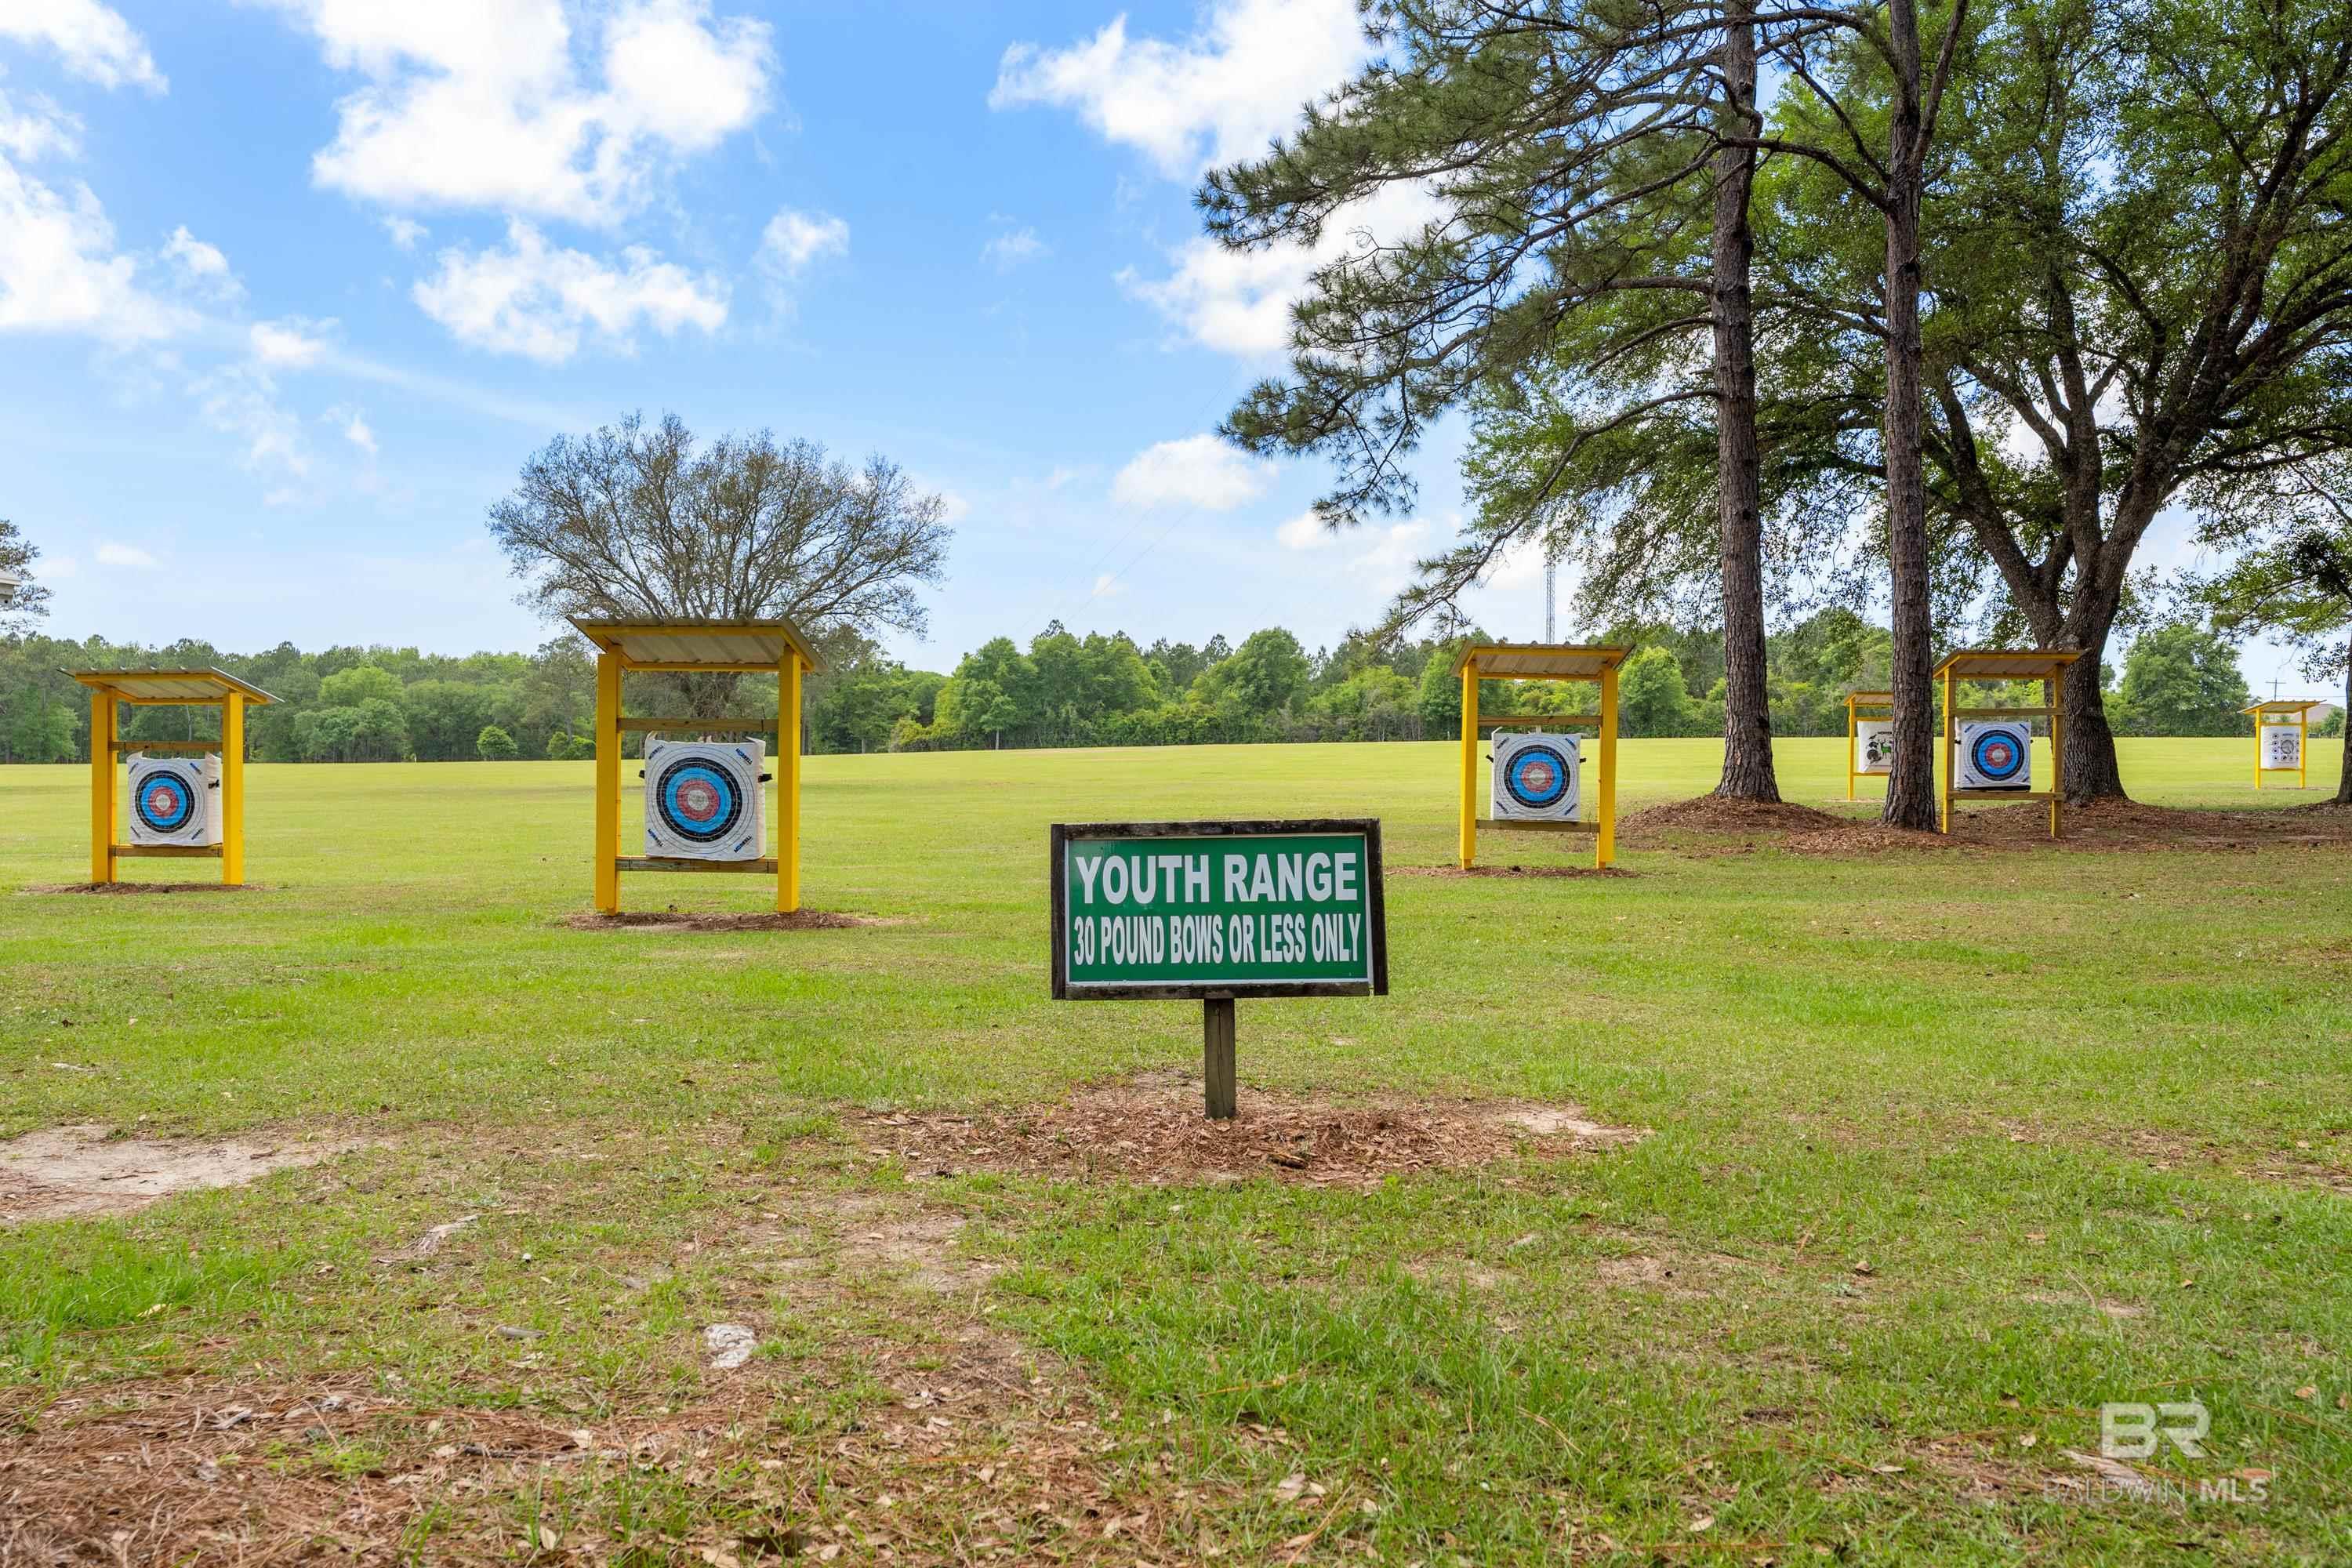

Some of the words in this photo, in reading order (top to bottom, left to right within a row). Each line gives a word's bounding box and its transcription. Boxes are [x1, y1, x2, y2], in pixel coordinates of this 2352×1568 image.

[1075, 855, 1210, 905] YOUTH
[1224, 852, 1358, 902] RANGE
[1074, 916, 1095, 965] 30
[1101, 916, 1164, 965] POUND
[1171, 914, 1224, 964] BOWS
[1229, 914, 1256, 964] OR
[1261, 913, 1306, 963] LESS
[1311, 913, 1361, 963] ONLY
